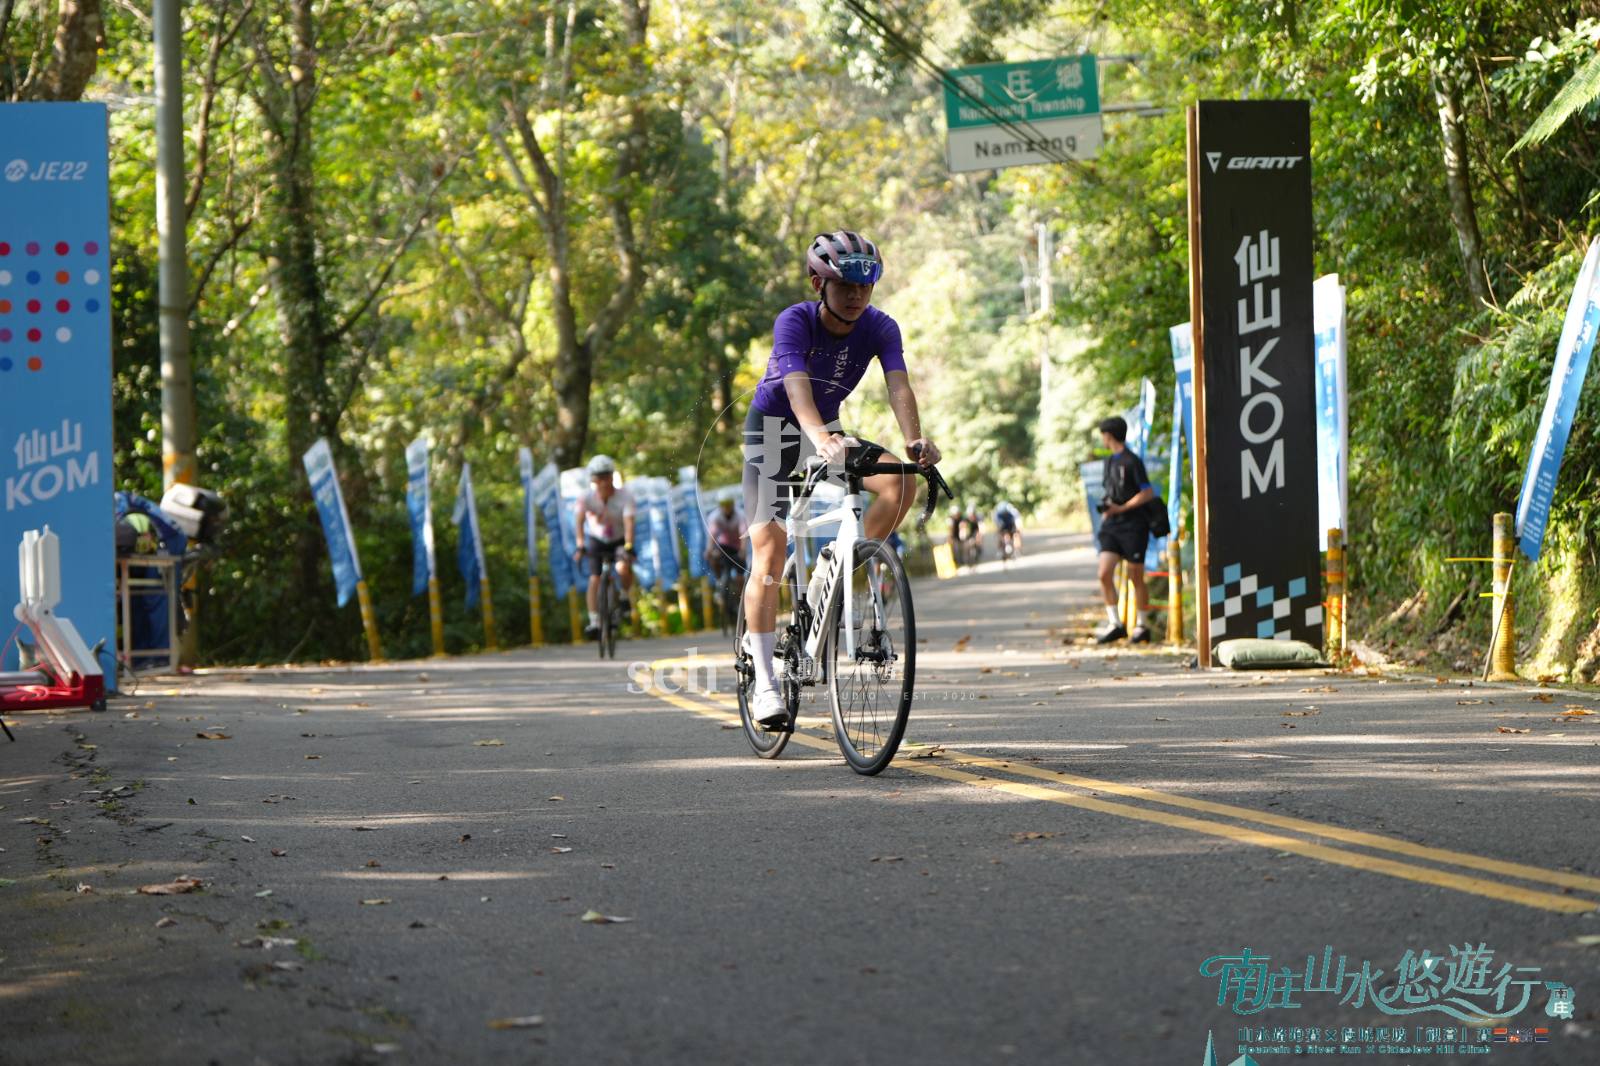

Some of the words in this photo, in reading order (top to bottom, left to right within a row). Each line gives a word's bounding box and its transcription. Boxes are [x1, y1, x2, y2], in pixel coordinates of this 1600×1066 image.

[1032, 95, 1086, 114] Township
[29, 161, 88, 181] JE22
[1226, 156, 1303, 169] GIANT
[833, 346, 849, 378] RYSEL
[14, 419, 82, 470] 仙山
[6, 450, 99, 512] KOM
